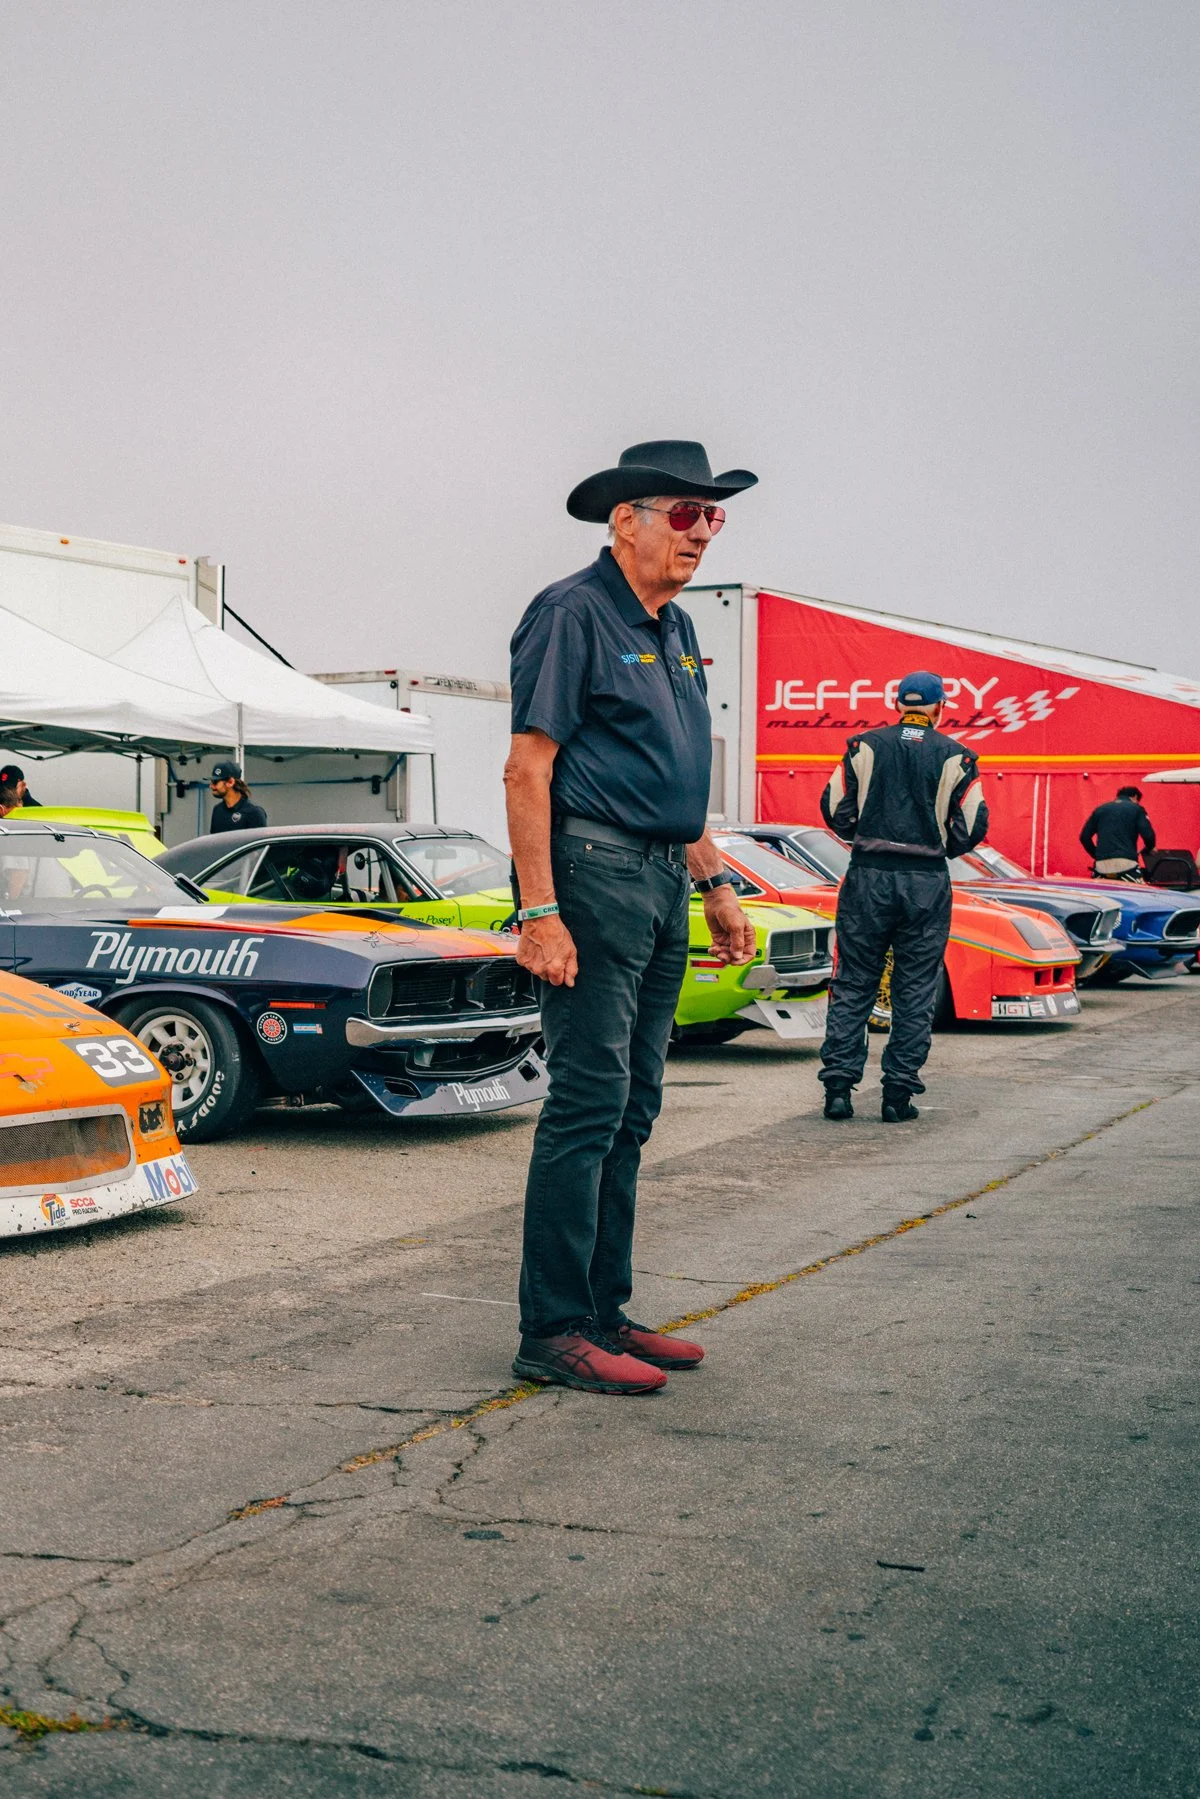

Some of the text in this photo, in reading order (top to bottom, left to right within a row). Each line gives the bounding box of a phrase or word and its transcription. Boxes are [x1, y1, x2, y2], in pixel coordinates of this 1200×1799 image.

[86, 931, 264, 984] Plymouth
[56, 988, 98, 998] OODYEAR
[76, 1039, 155, 1078] 33
[447, 1078, 511, 1112] Plymouth
[143, 1154, 197, 1201] Mobi
[45, 1200, 66, 1226] Tide
[69, 1197, 96, 1208] SCCA
